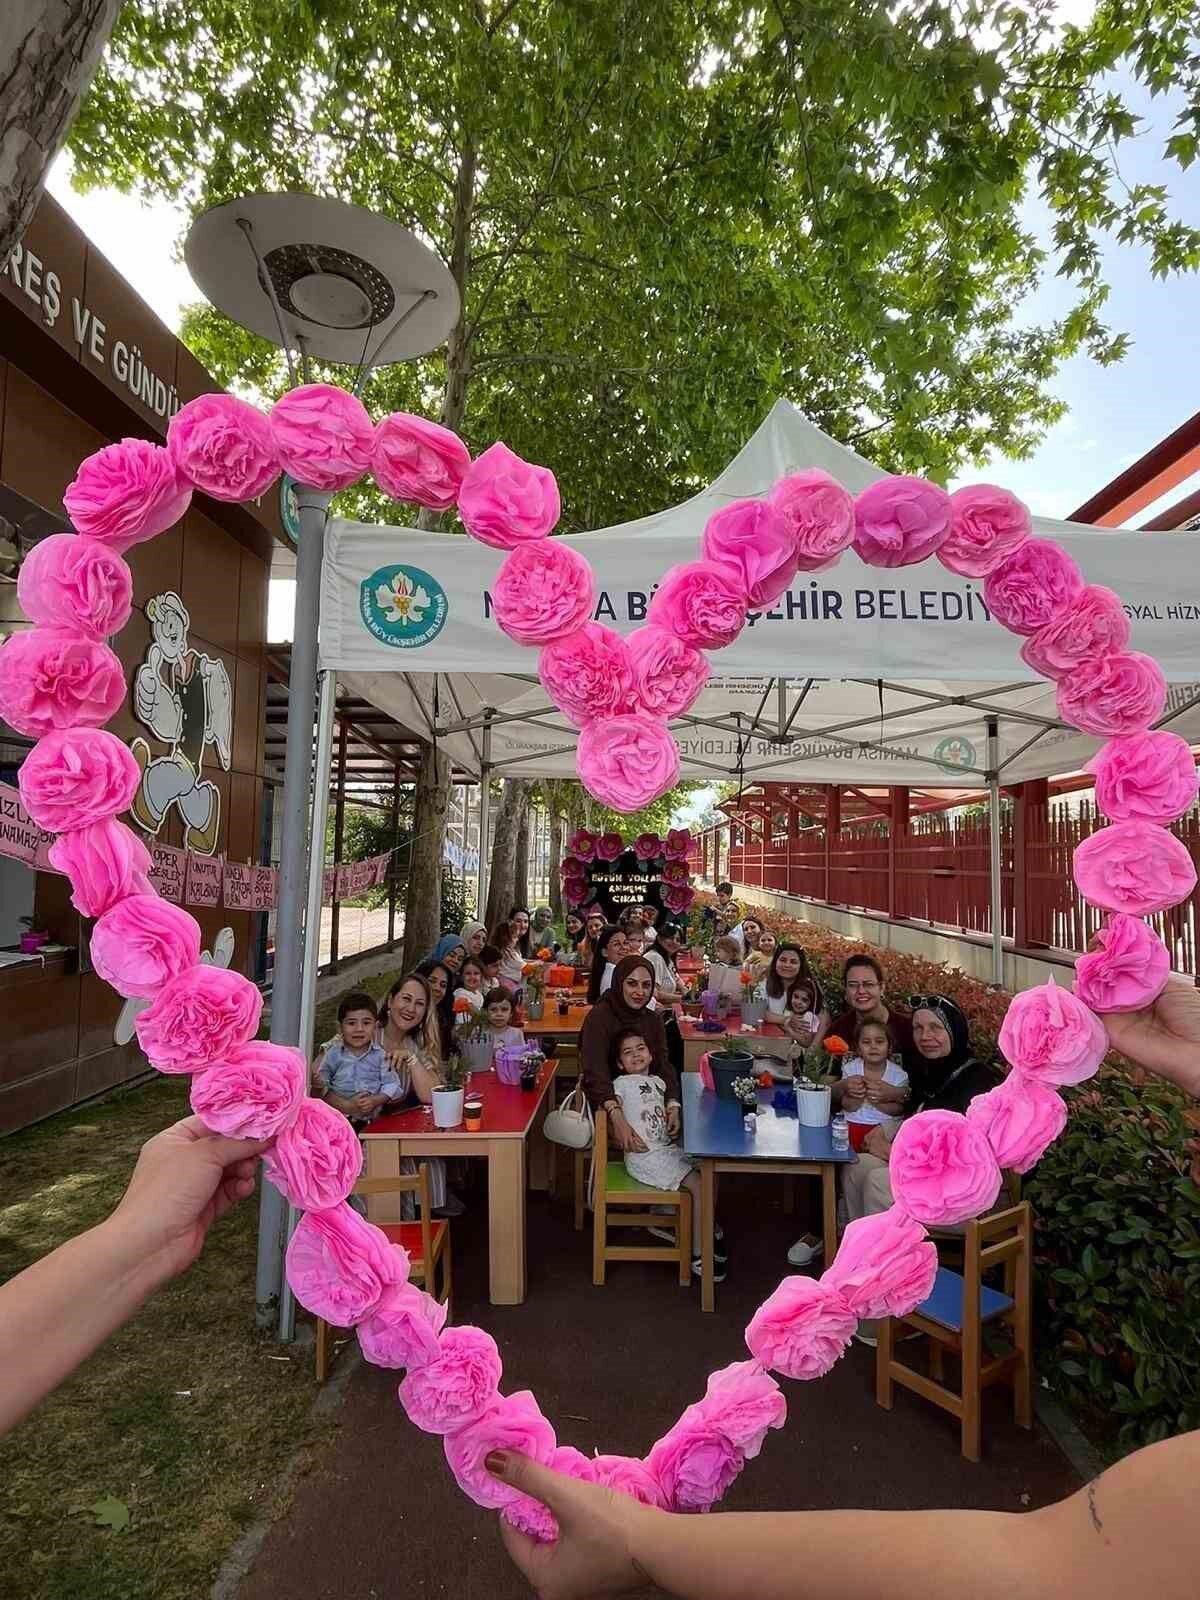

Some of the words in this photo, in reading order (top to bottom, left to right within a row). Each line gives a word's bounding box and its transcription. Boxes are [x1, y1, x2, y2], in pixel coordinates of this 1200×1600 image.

[4, 241, 61, 326] REŞ
[71, 297, 106, 363] VE
[113, 341, 184, 417] GÜNDÜ
[855, 583, 991, 621] BELEDİY
